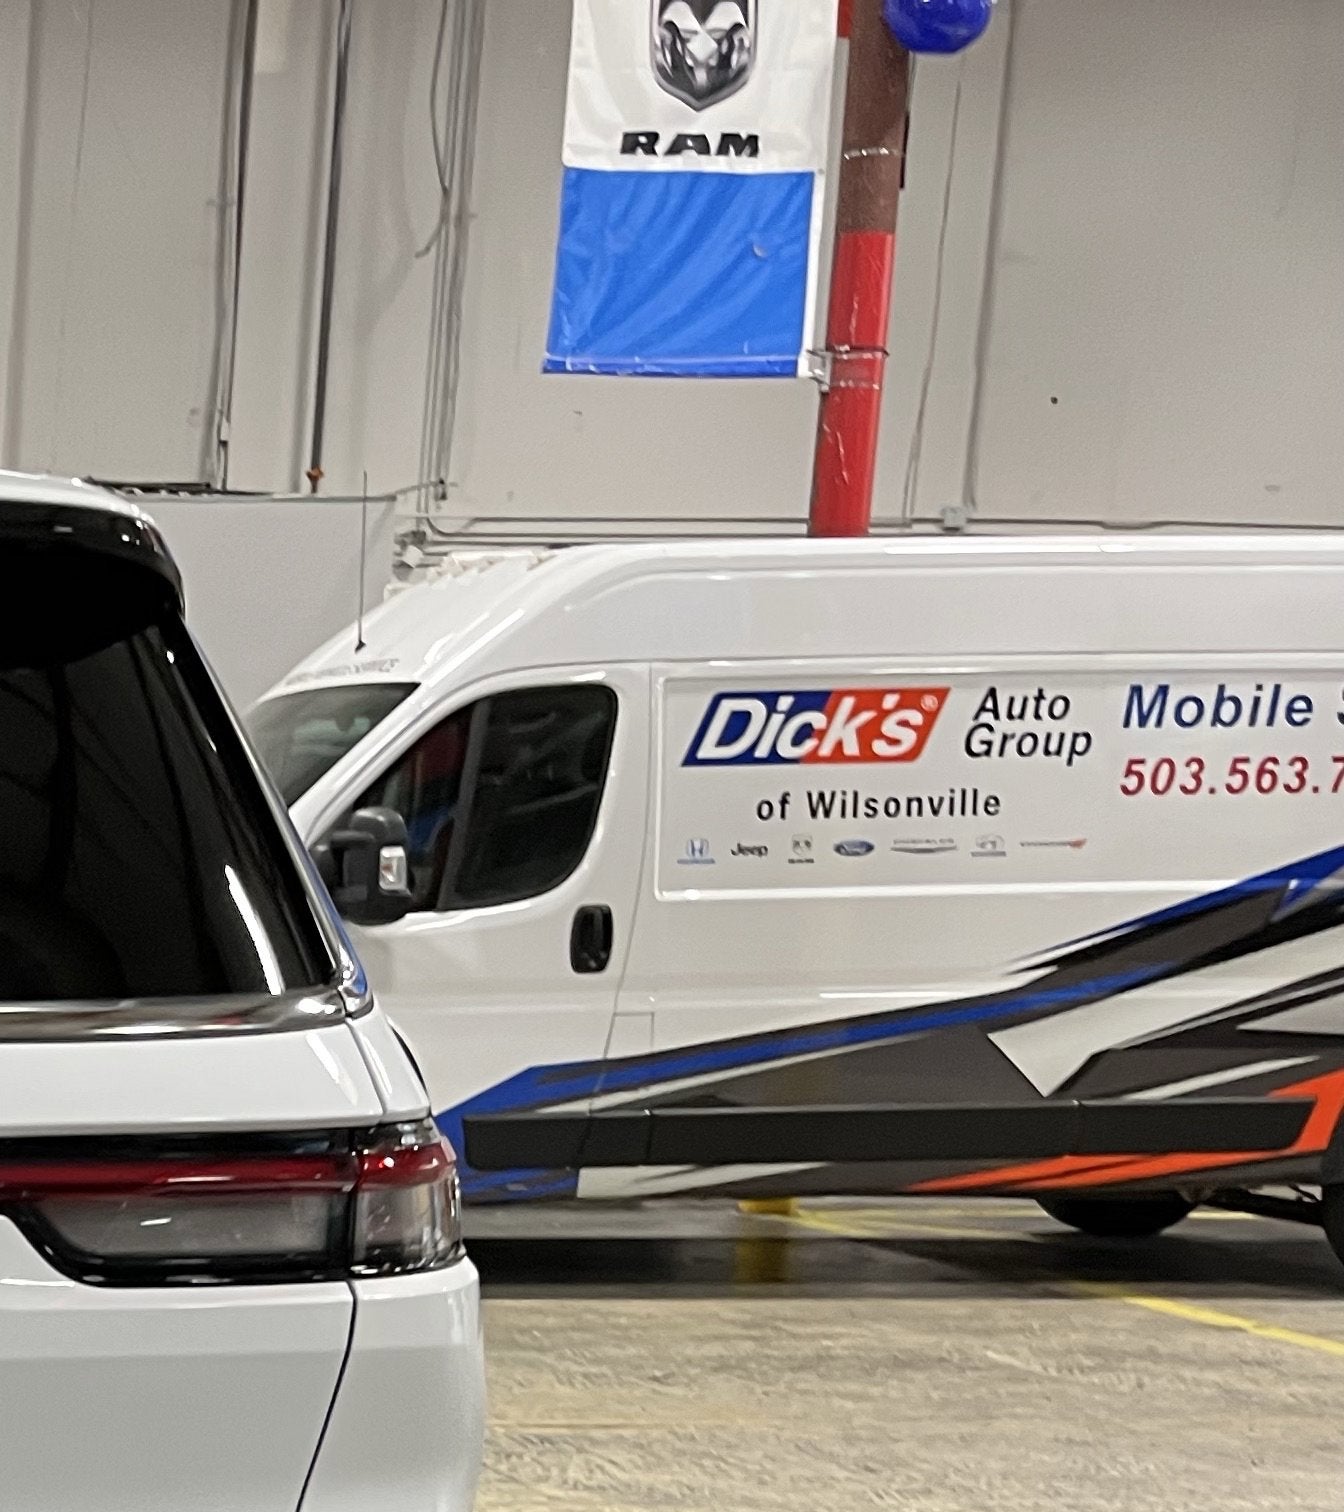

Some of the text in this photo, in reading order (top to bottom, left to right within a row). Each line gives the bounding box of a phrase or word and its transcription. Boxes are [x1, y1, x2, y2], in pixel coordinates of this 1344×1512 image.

[620, 132, 760, 158] RAM
[971, 686, 1072, 722] Auto
[1121, 684, 1313, 729] Mobile
[964, 723, 1092, 766] Group
[756, 788, 1002, 821] of Wilsonville
